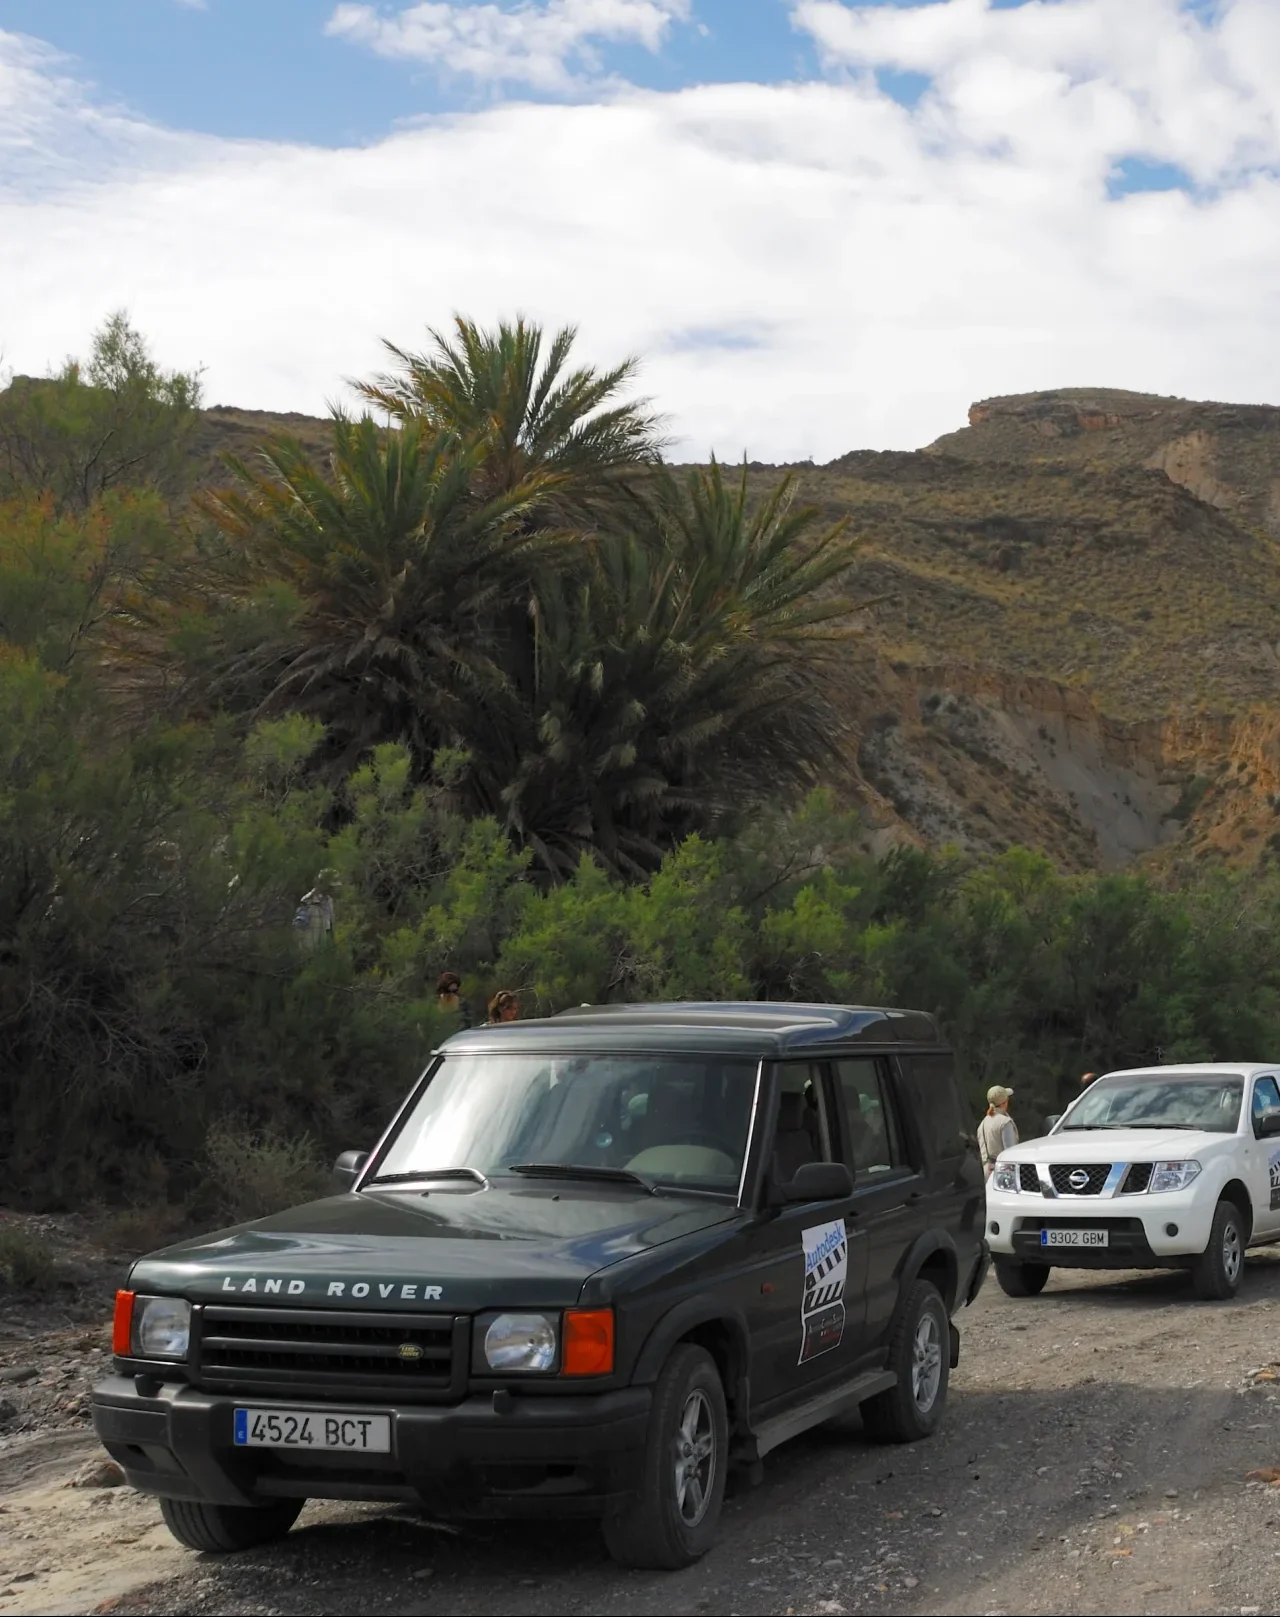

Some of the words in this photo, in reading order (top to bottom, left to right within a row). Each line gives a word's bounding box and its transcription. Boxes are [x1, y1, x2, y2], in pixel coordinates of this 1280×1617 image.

[806, 1222, 844, 1273] Autodesk
[1050, 1232, 1078, 1244] 9302
[1082, 1232, 1104, 1244] GBM
[221, 1277, 305, 1294] LAND
[327, 1281, 443, 1300] ROVER
[238, 1431, 245, 1439] E
[251, 1414, 314, 1445] 4524
[325, 1418, 372, 1447] BCT
